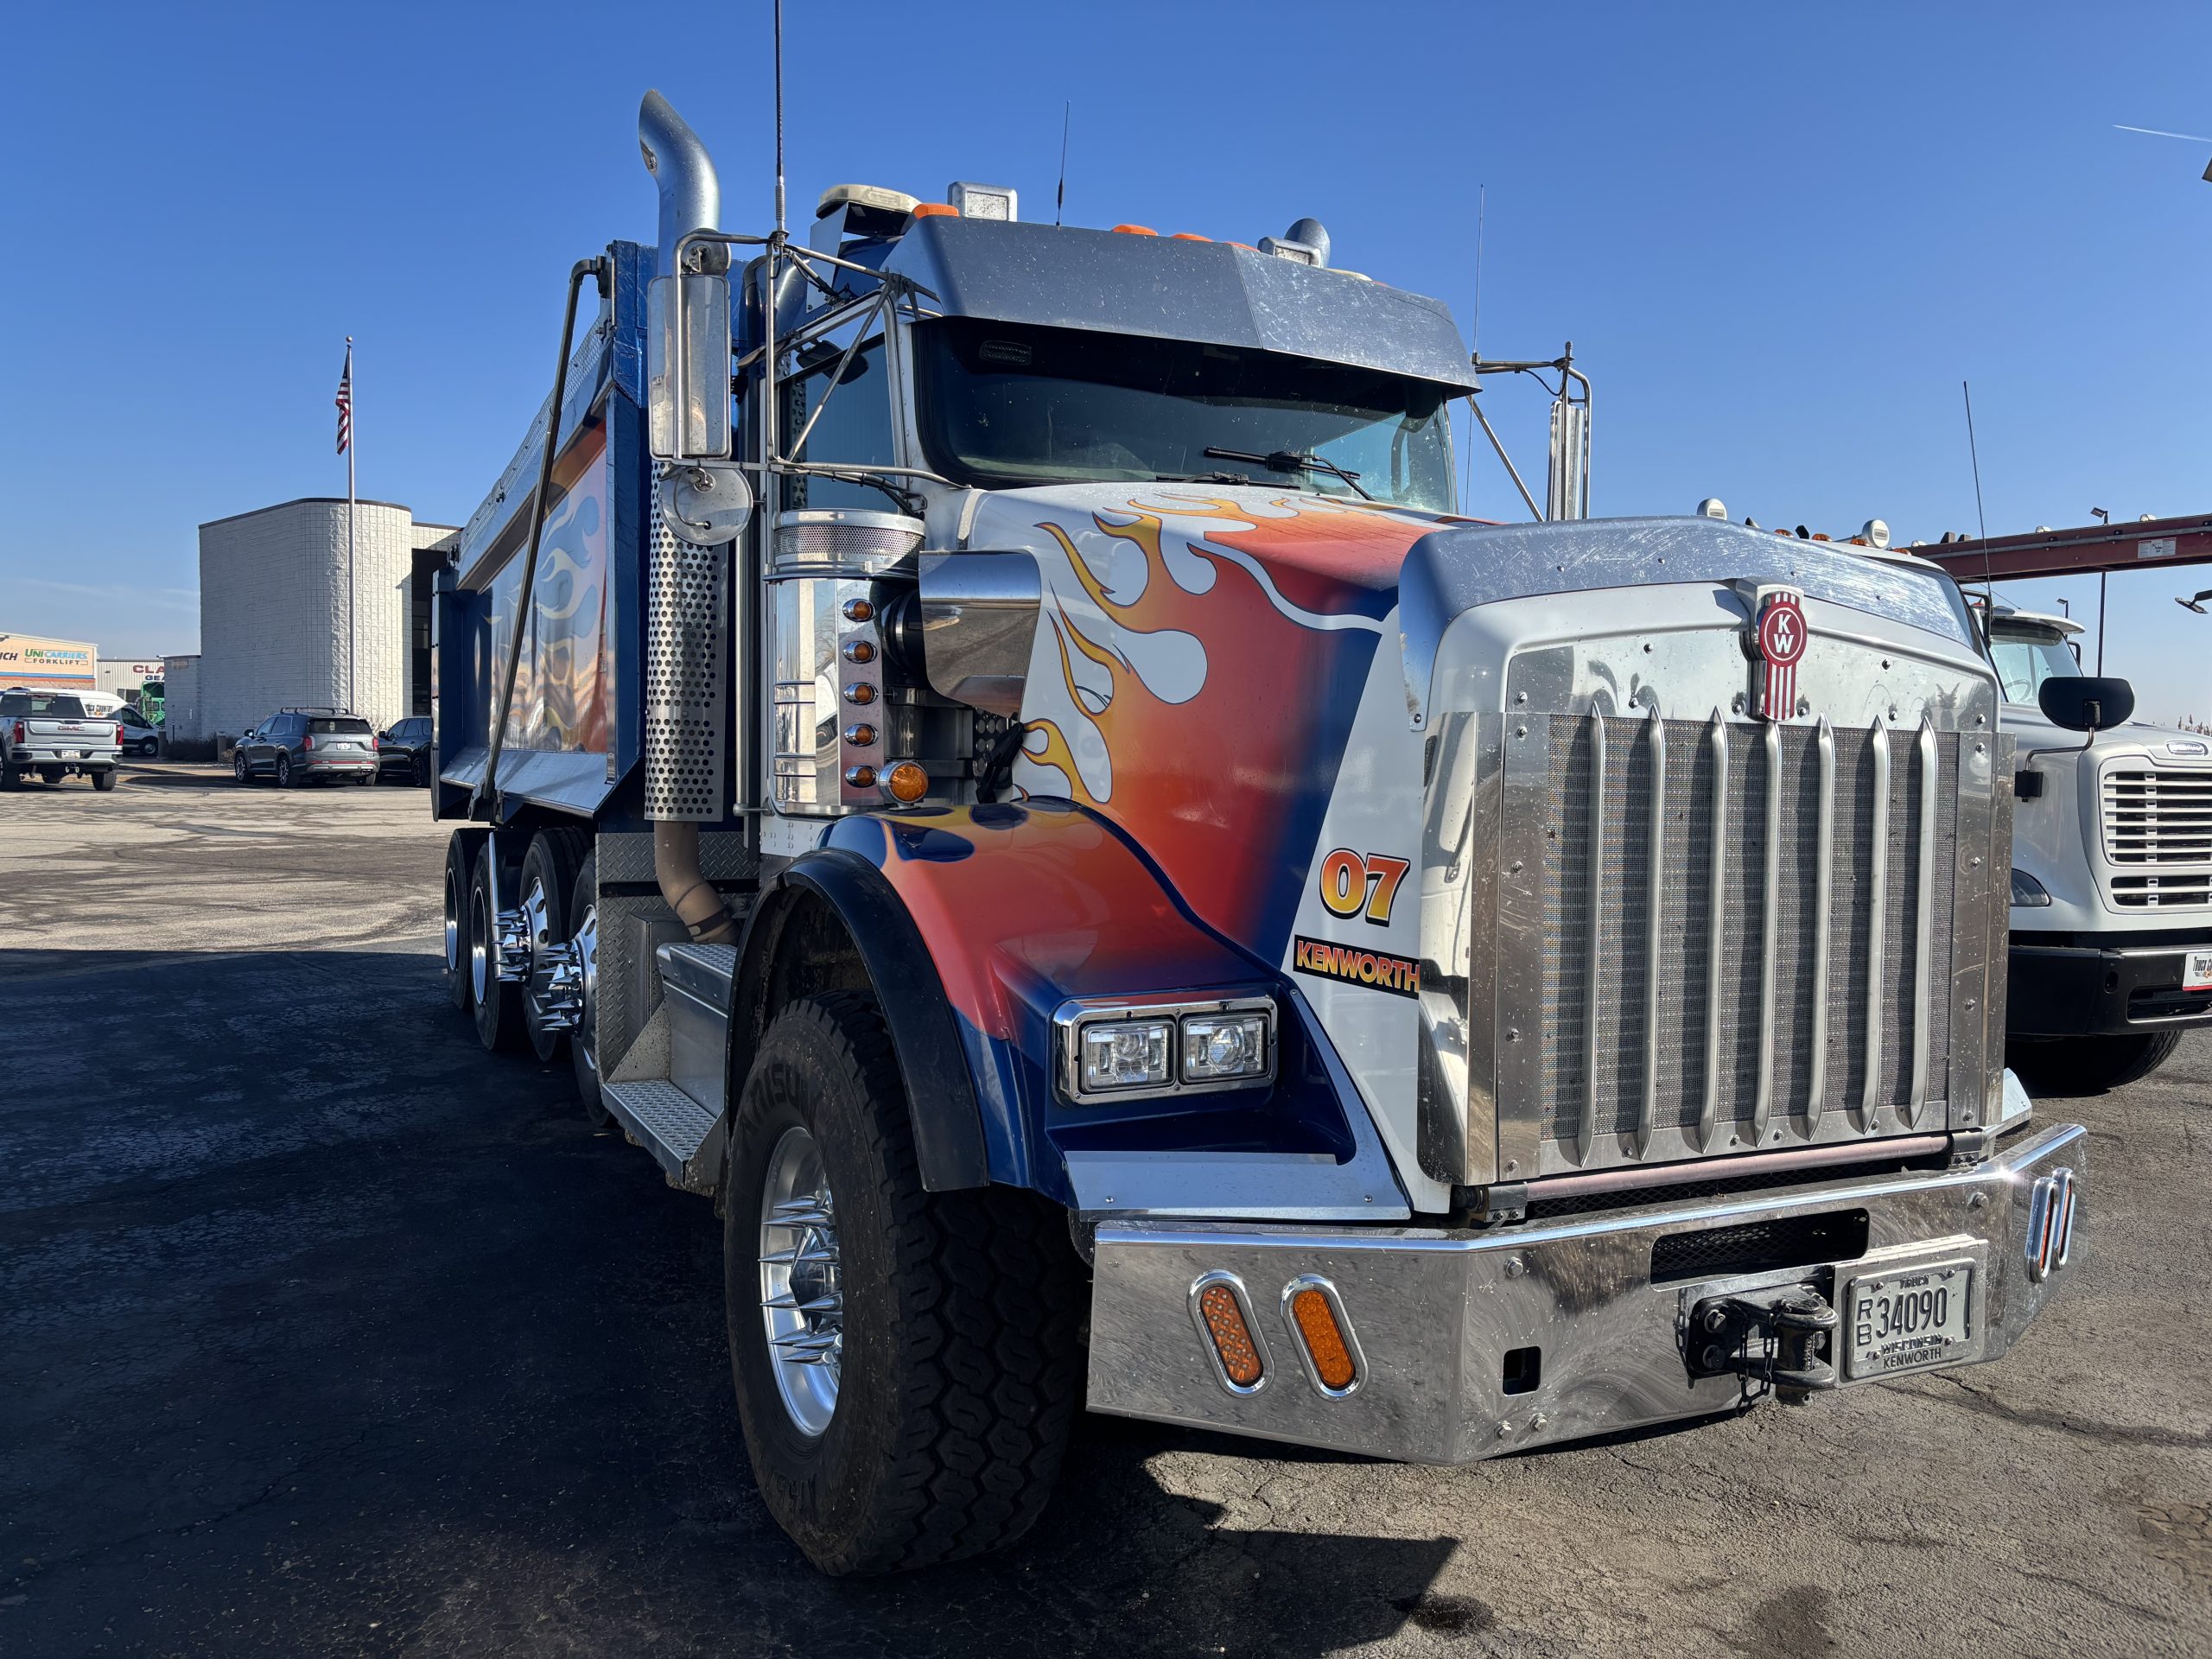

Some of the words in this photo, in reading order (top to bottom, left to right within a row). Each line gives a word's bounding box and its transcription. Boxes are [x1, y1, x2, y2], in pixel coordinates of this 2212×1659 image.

[1319, 847, 1411, 928] 07
[1296, 939, 1421, 994] KENWORTH
[1900, 1275, 1930, 1289] TRUCK
[1876, 1285, 1948, 1338] 34090
[1881, 1332, 1943, 1355] WISCONSIN
[1883, 1347, 1942, 1370] KENWORTH
